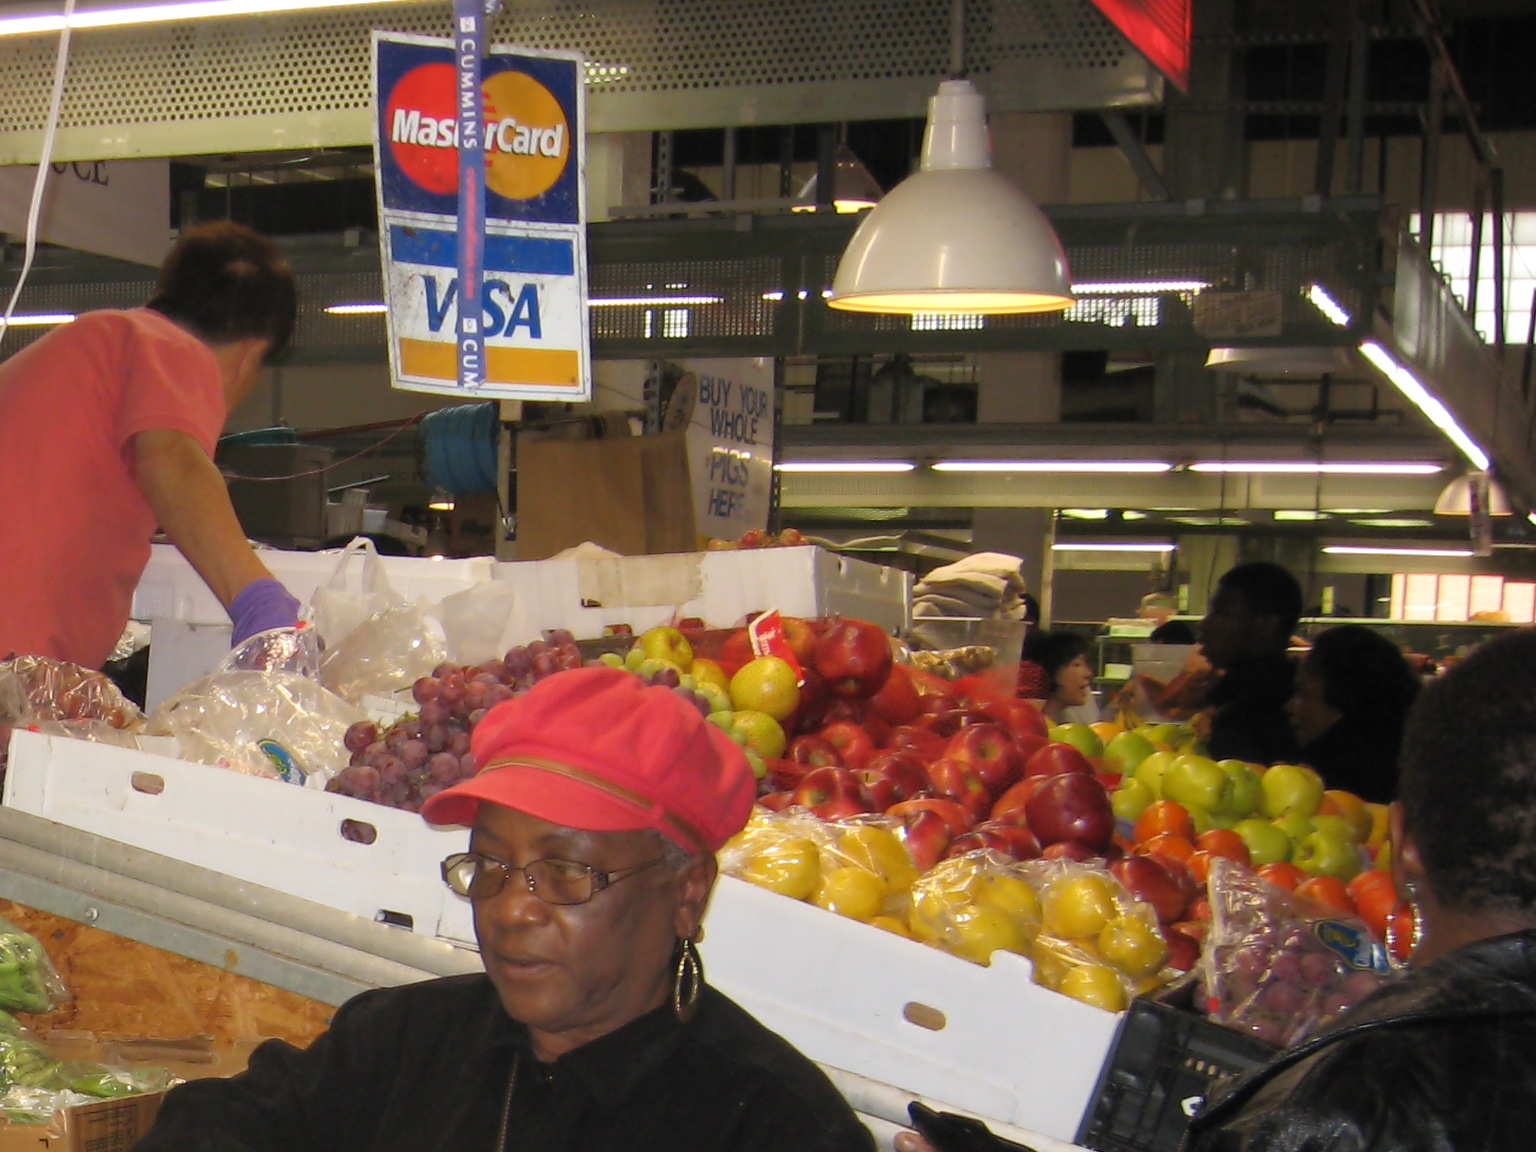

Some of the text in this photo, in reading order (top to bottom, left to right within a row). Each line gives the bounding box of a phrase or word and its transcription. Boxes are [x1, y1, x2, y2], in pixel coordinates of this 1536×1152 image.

[460, 38, 478, 150] CUMMINS
[392, 108, 563, 157] MasrCard
[419, 274, 542, 339] VSA
[699, 375, 768, 417] BUY YOUR
[710, 407, 757, 445] WHOLE
